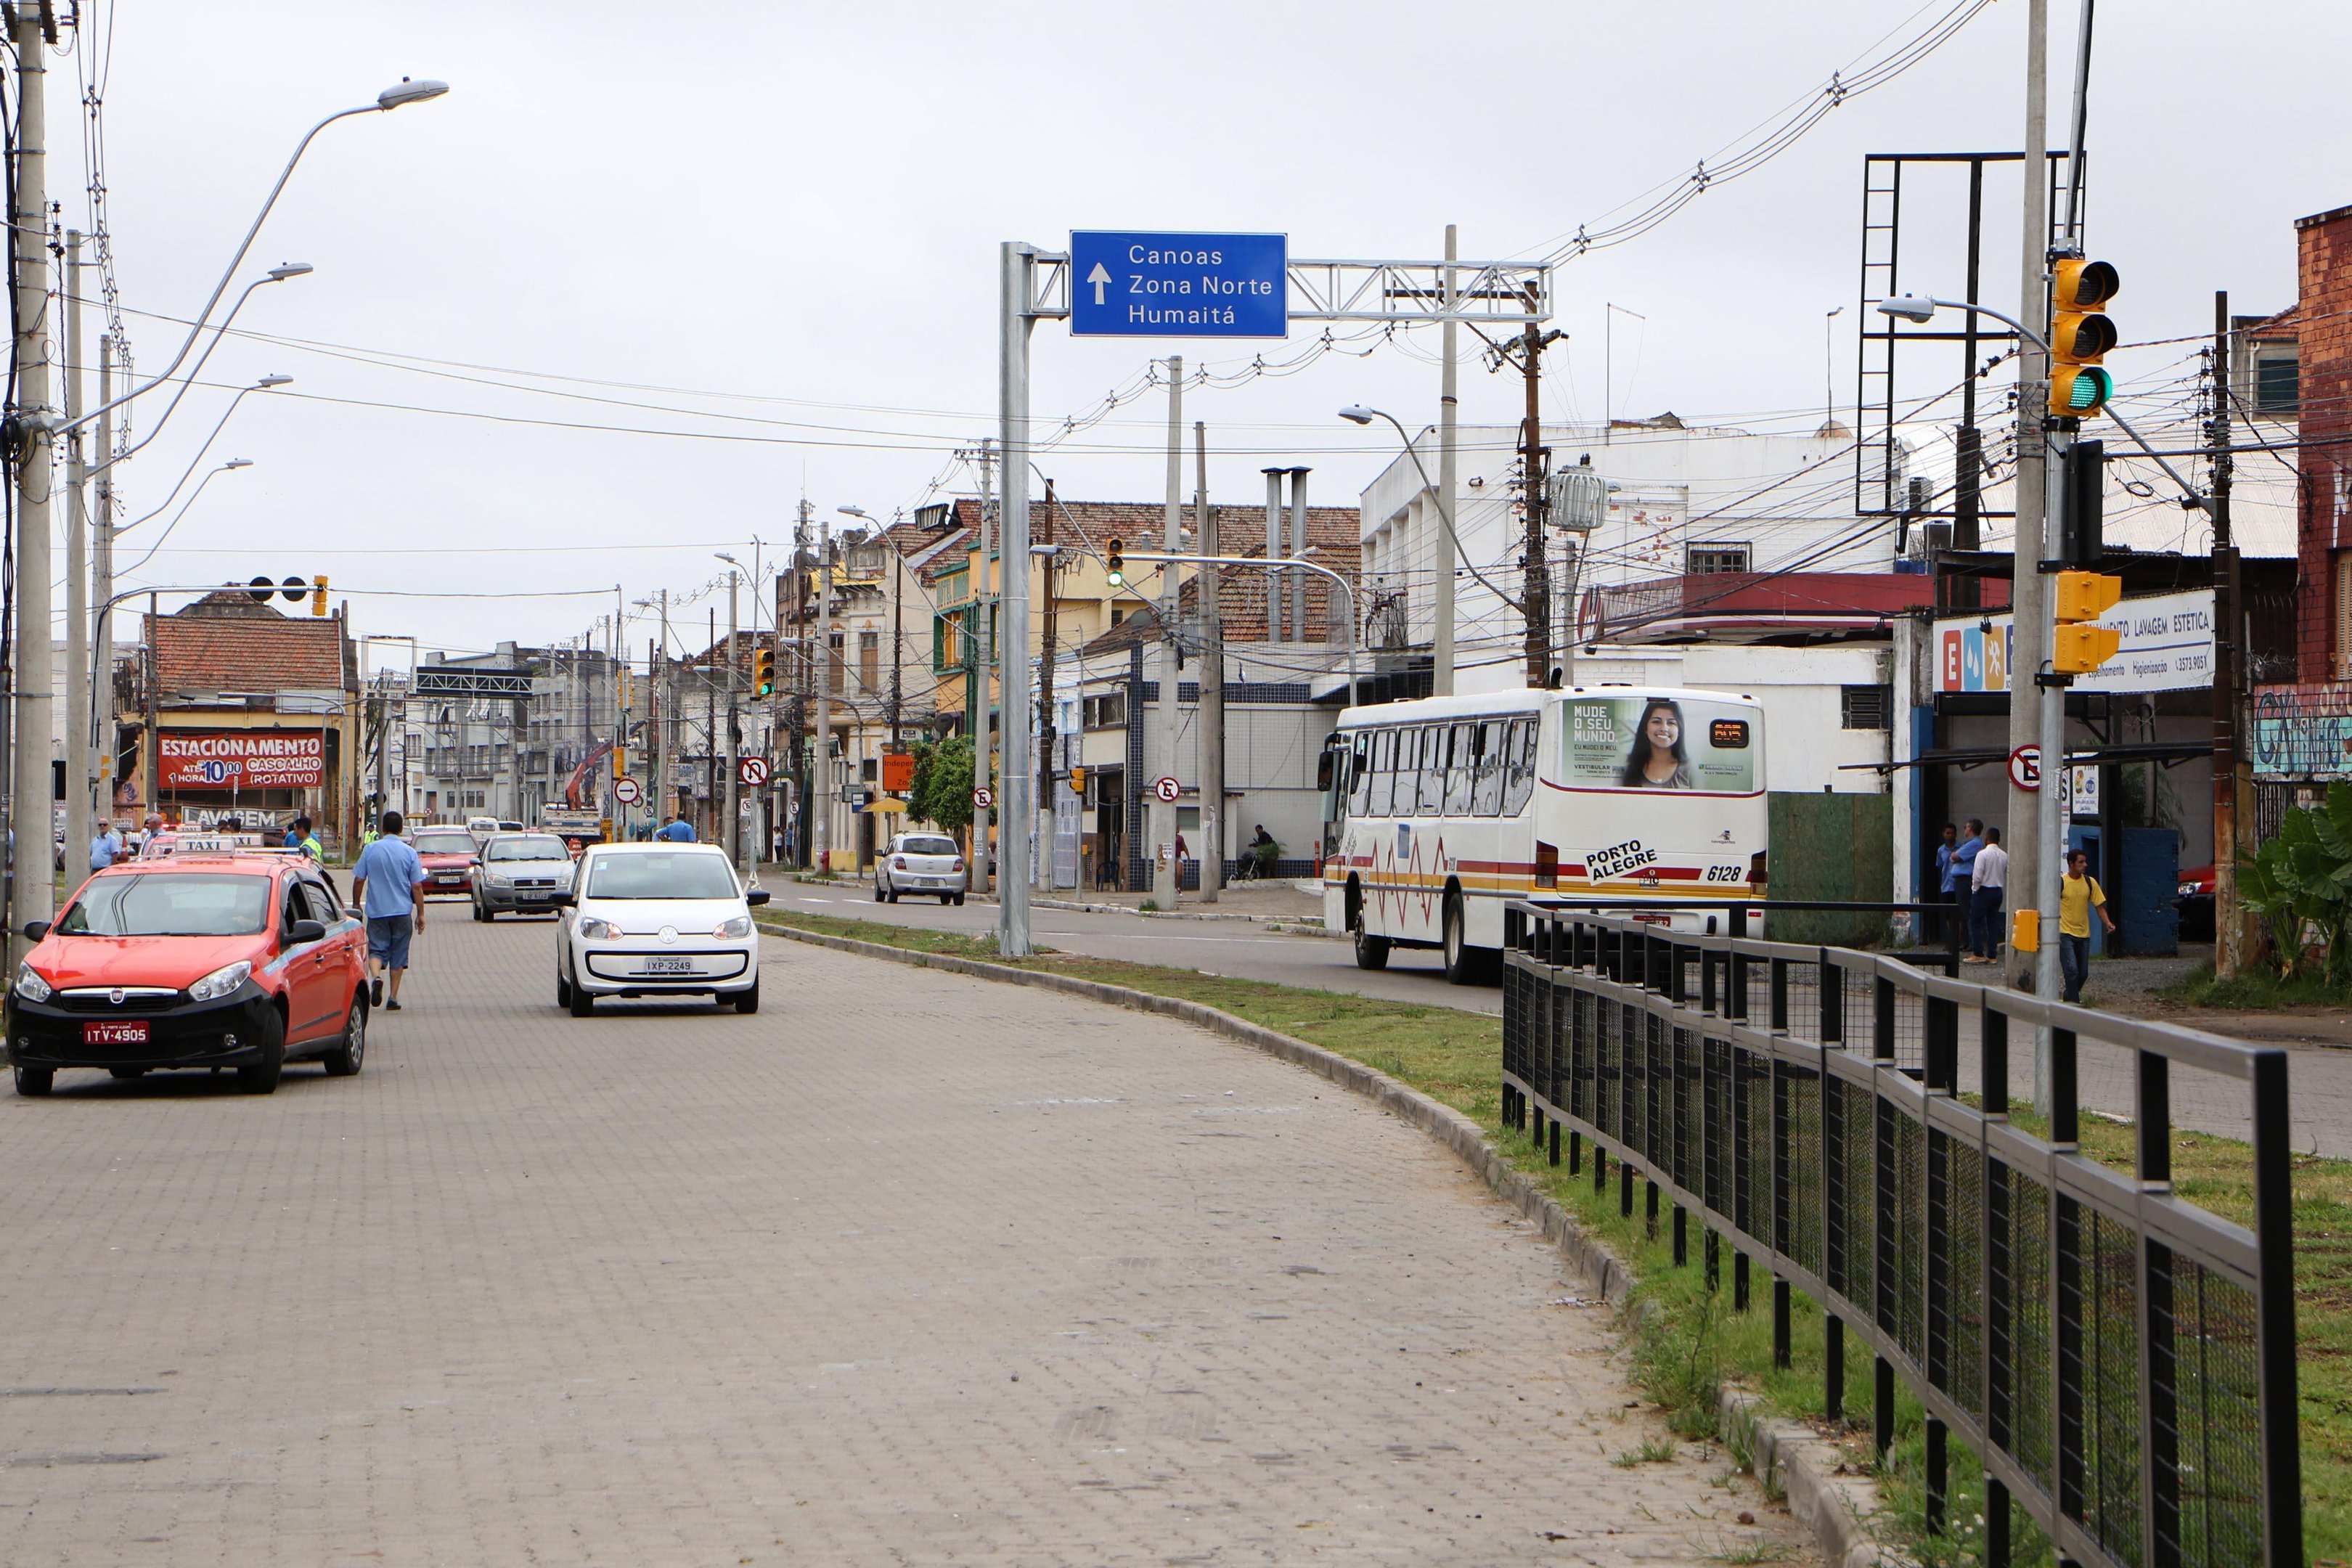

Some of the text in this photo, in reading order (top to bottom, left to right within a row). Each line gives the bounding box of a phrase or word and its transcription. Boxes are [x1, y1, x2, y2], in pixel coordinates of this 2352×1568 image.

[1129, 245, 1222, 265] Canoas
[1130, 275, 1272, 295] Zona Norte
[1129, 305, 1235, 324] Humaitá
[2134, 616, 2168, 637] LAVAGEM
[2173, 608, 2209, 632] ESTÉTICA
[2133, 660, 2168, 678] Higienização
[1574, 705, 1607, 718] MUDE
[1575, 718, 1612, 730] O SEU
[1574, 730, 1618, 743] MUNDO.
[161, 738, 320, 756] ESTACIONAMENTO
[246, 756, 322, 772] CASCALHO
[179, 774, 205, 783] HORA
[250, 772, 318, 785] (ROTATIVO)
[187, 841, 221, 850] TAXI
[1586, 840, 1641, 867] PORTO
[1592, 849, 1658, 881] ALEGRE
[1707, 865, 1741, 882] 6128
[648, 962, 690, 971] IXP-2249
[87, 1029, 146, 1042] ITV-4905
